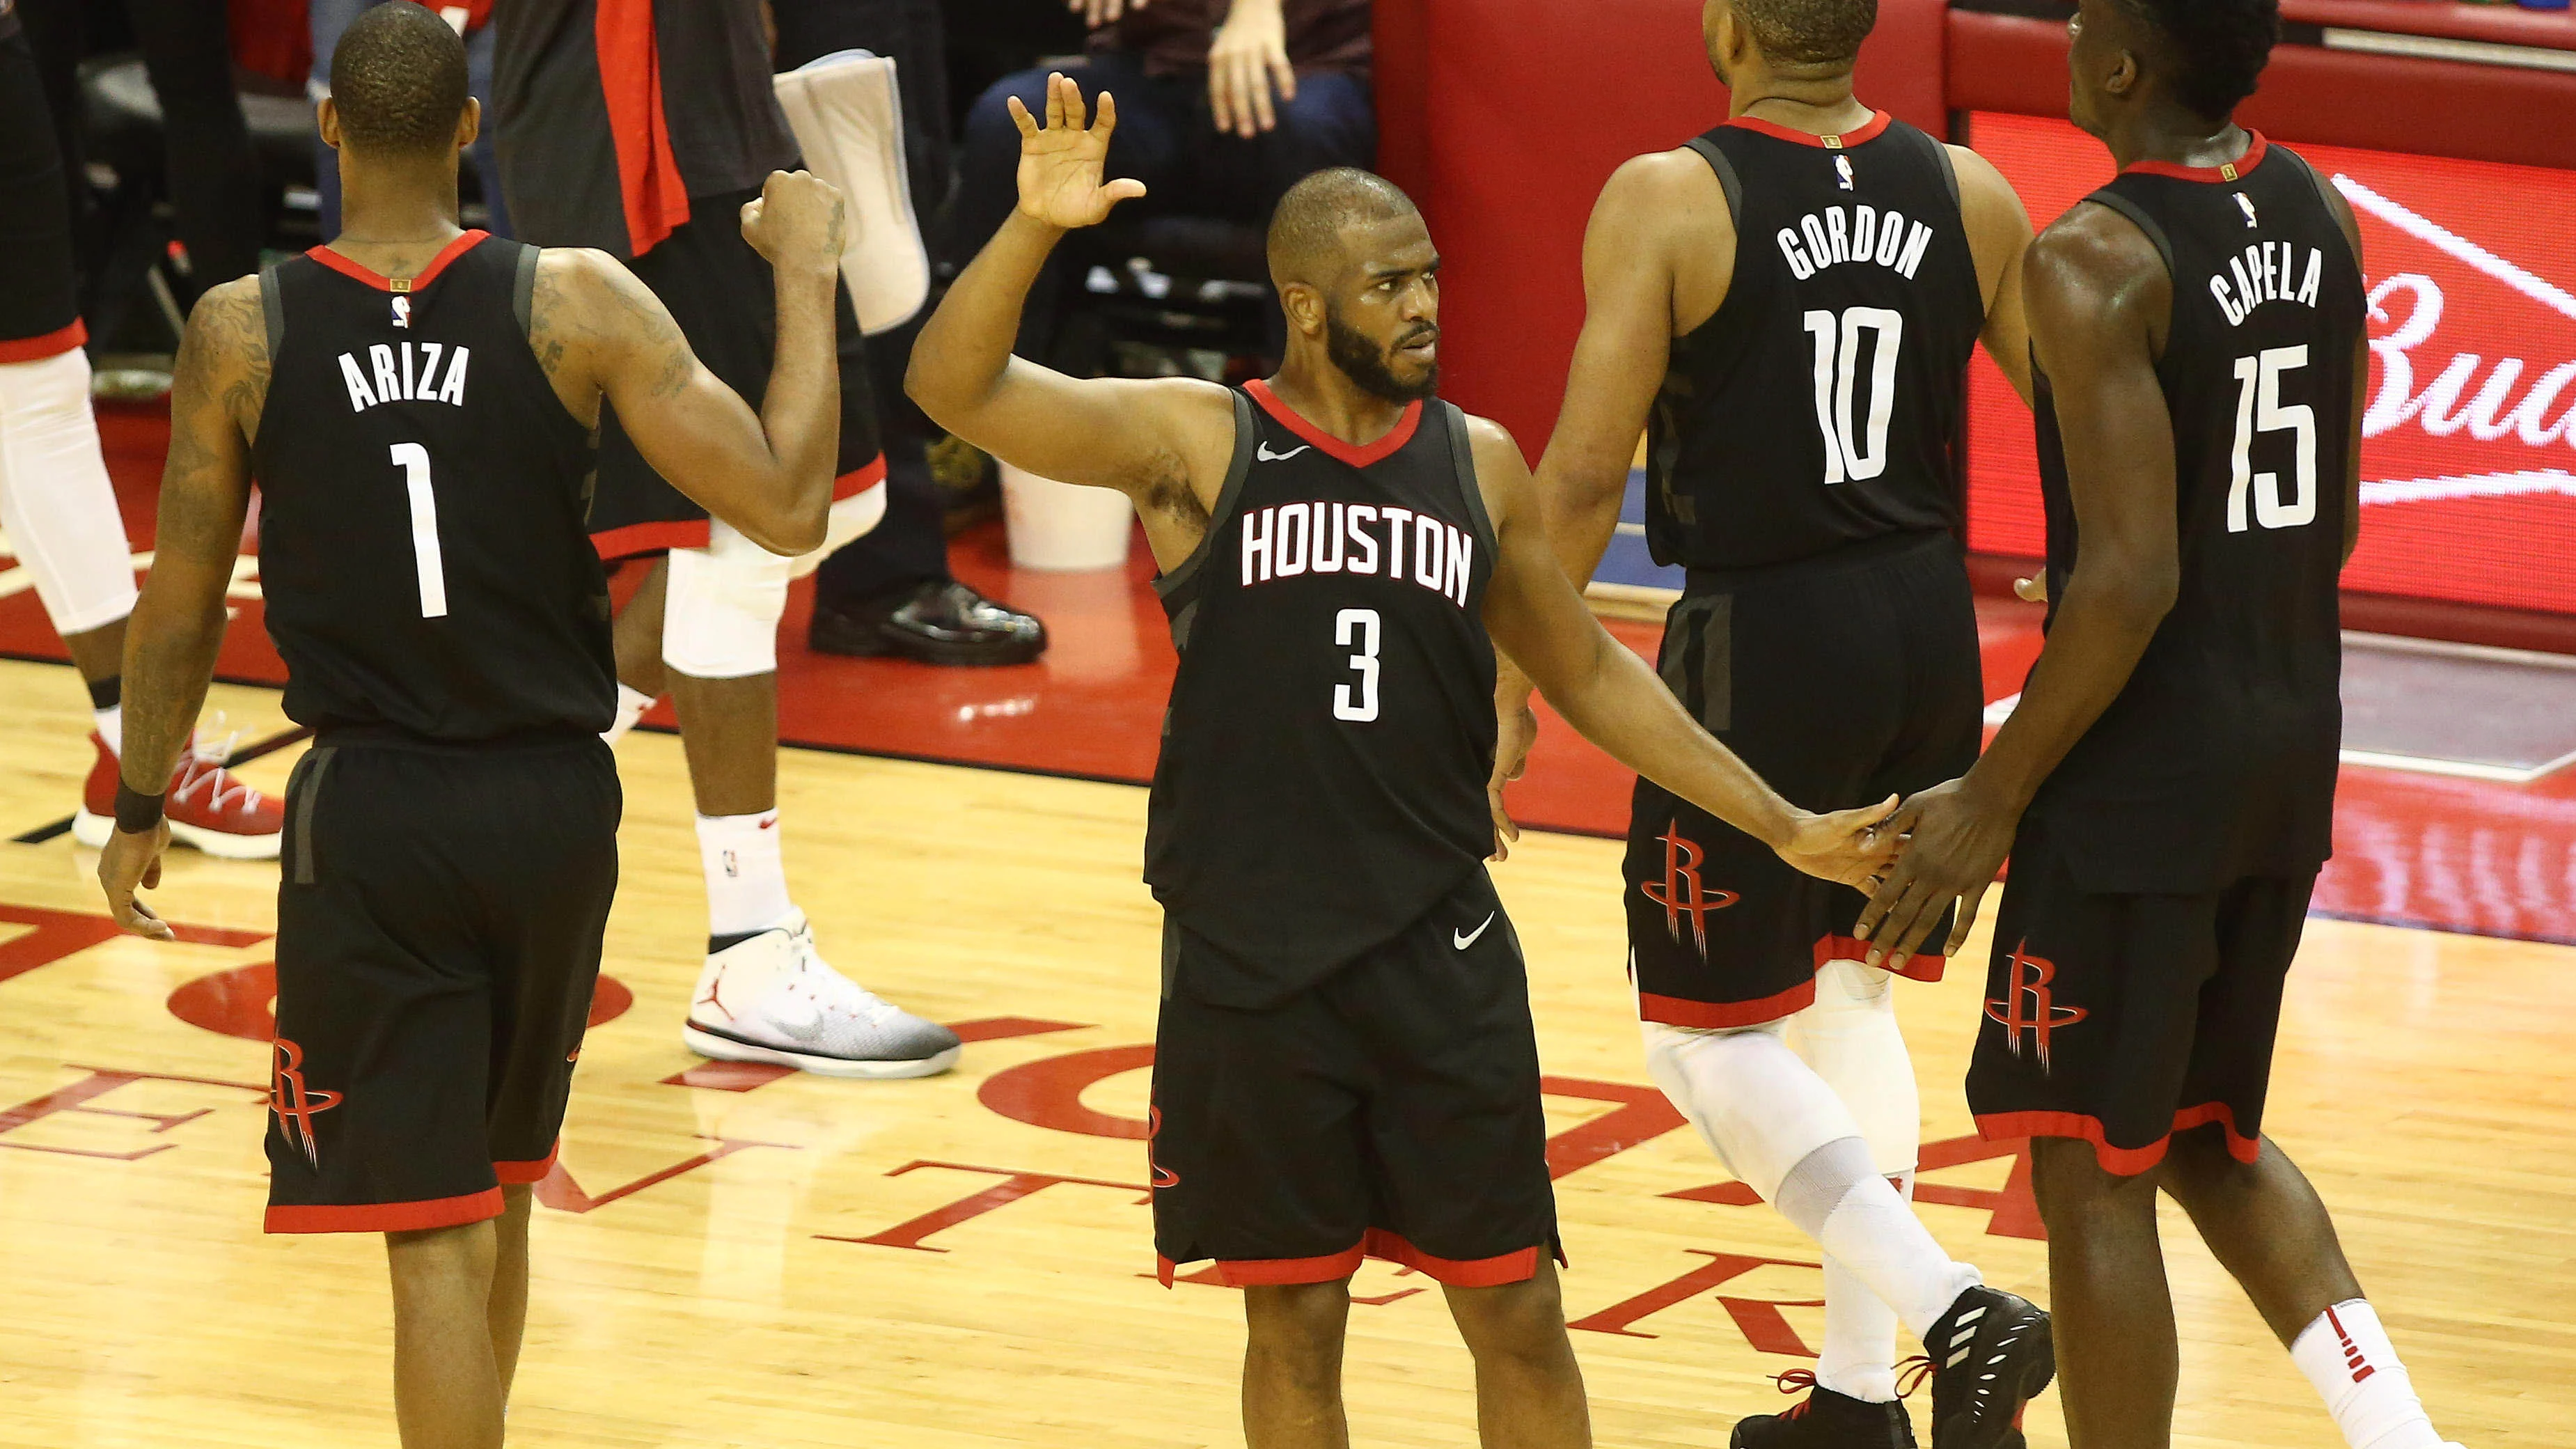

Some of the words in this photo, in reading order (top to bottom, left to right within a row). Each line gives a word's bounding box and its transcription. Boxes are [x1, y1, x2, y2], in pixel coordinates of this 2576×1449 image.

[1777, 204, 1933, 281] GORDON
[2210, 240, 2322, 327] CAPELA
[338, 341, 471, 413] ARIZA
[1803, 306, 1903, 485] 10
[2226, 344, 2317, 533] 15
[390, 442, 448, 618] 1
[1240, 499, 1474, 609] HOUSTON
[1333, 608, 1381, 722] 3
